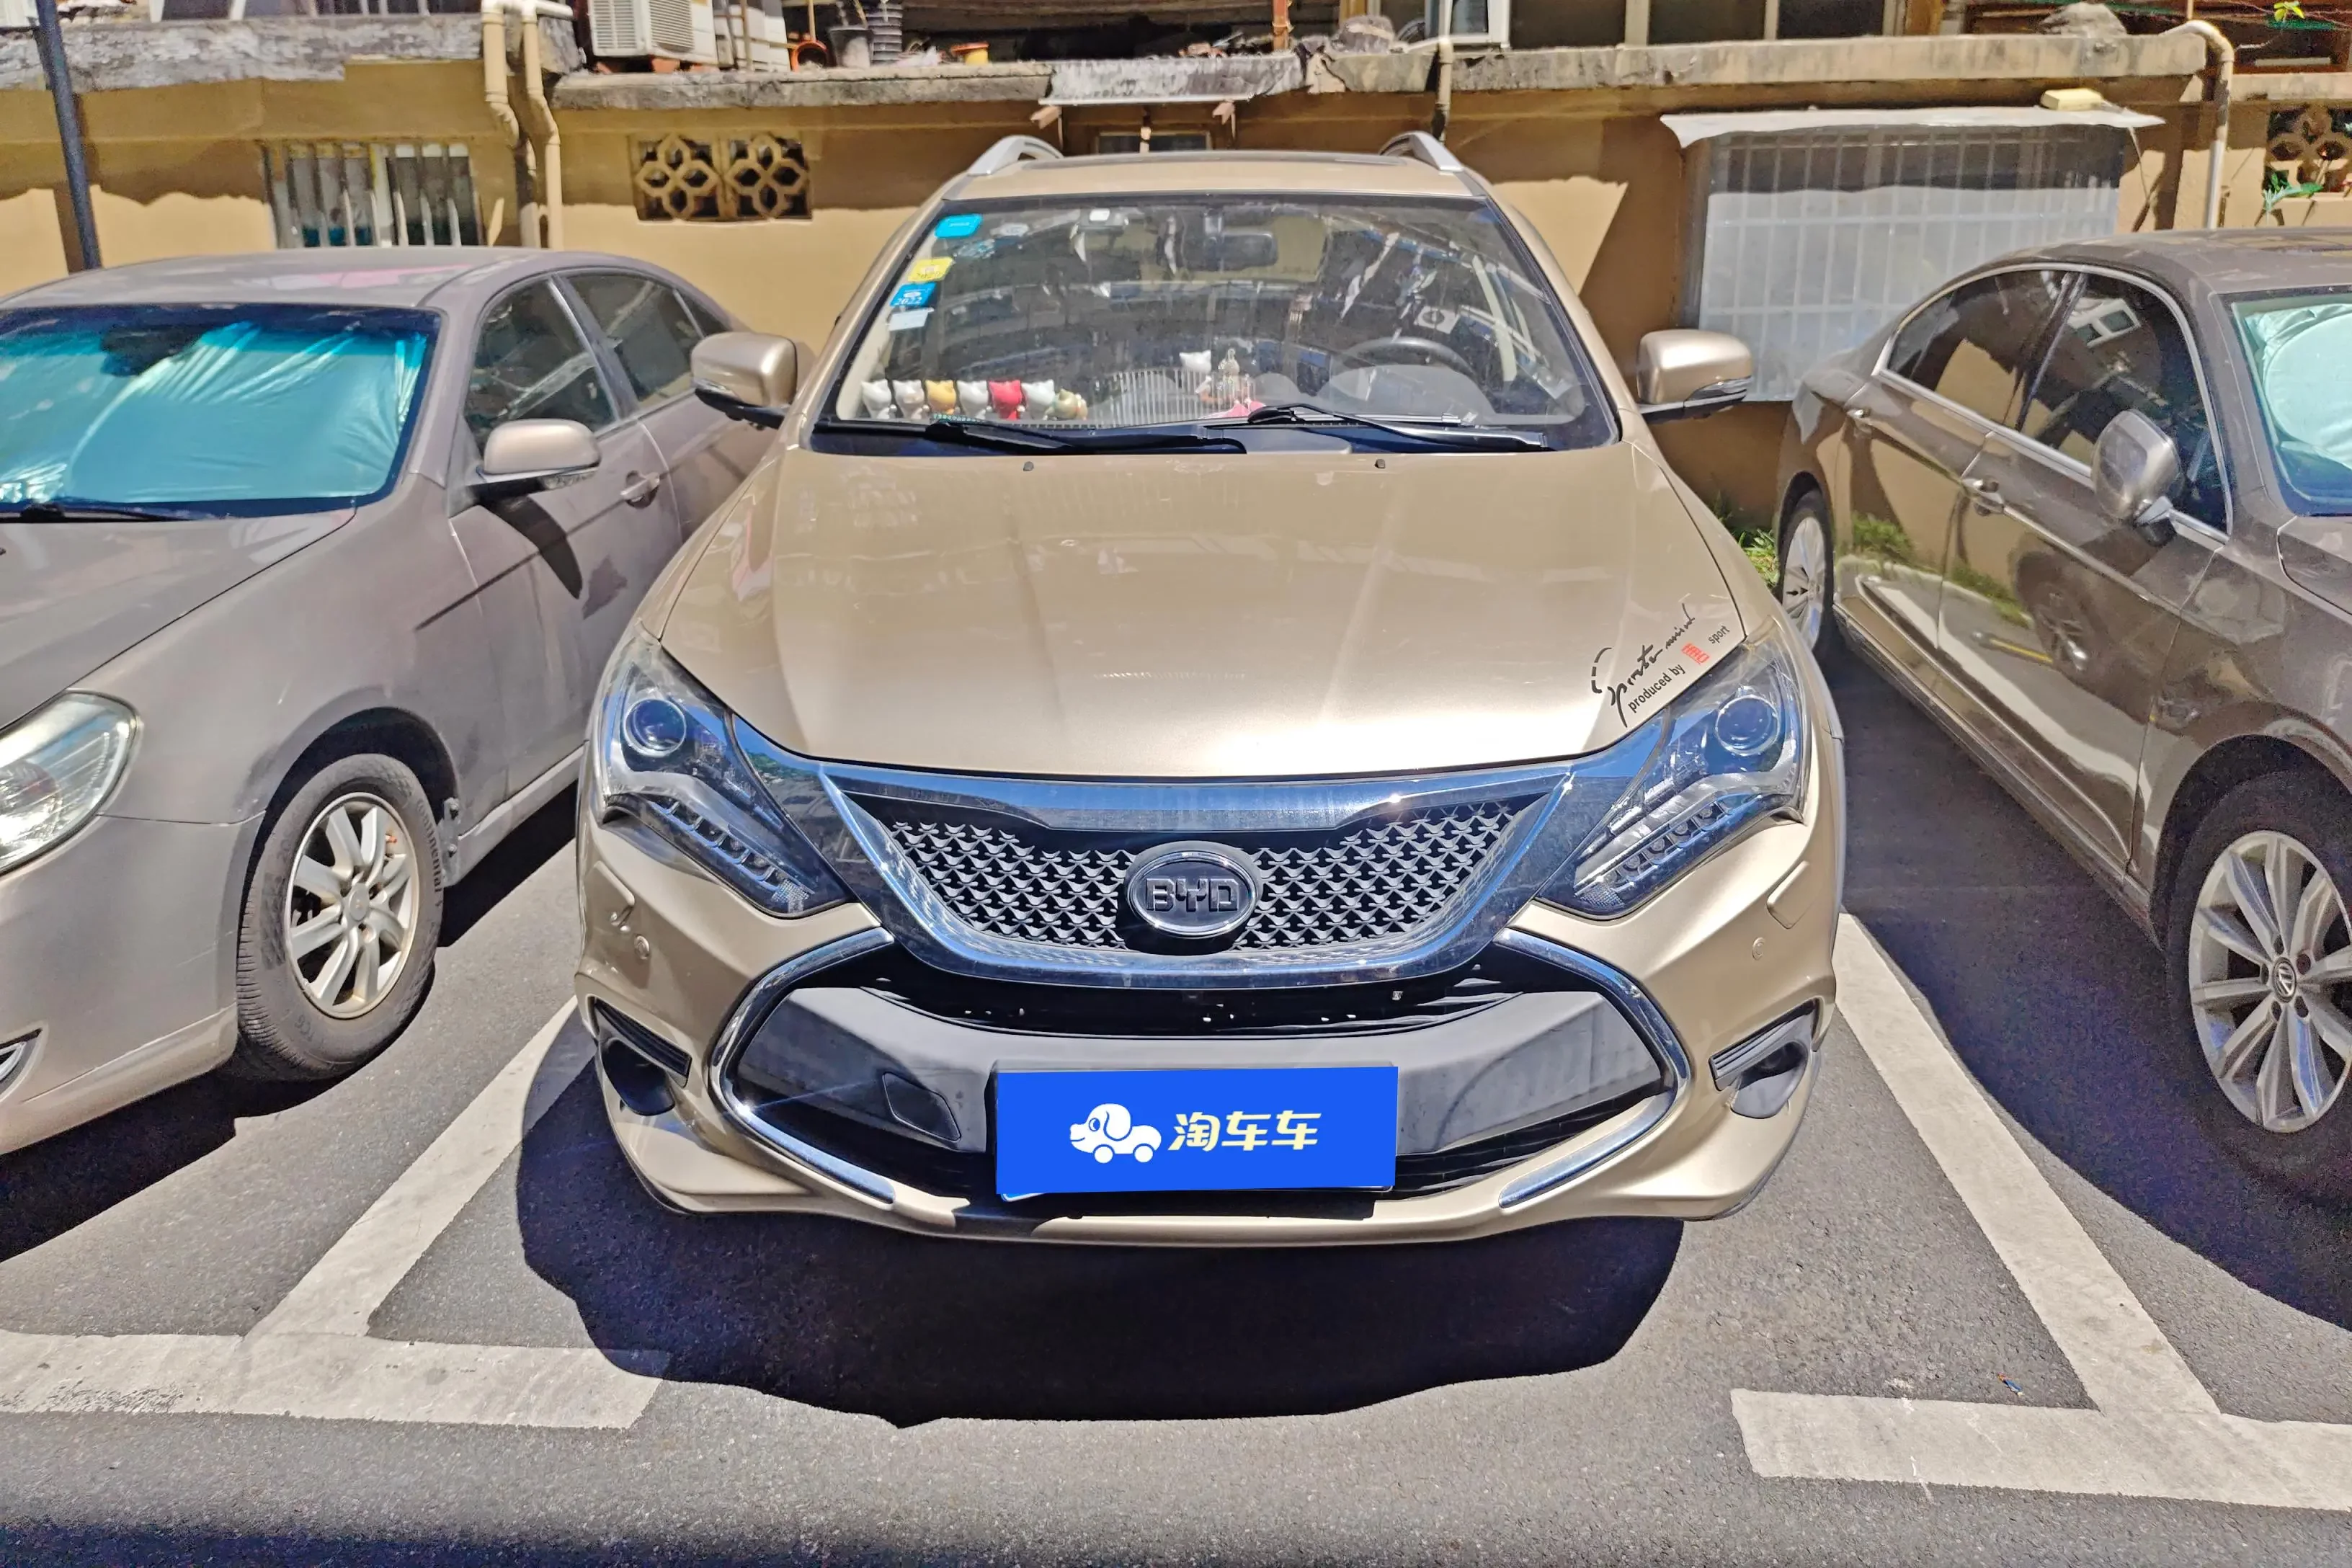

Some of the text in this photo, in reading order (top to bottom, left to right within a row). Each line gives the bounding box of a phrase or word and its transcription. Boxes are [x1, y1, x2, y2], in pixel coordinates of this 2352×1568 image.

[1628, 625, 1731, 713] produced by sport
[1146, 877, 1239, 912] BYD
